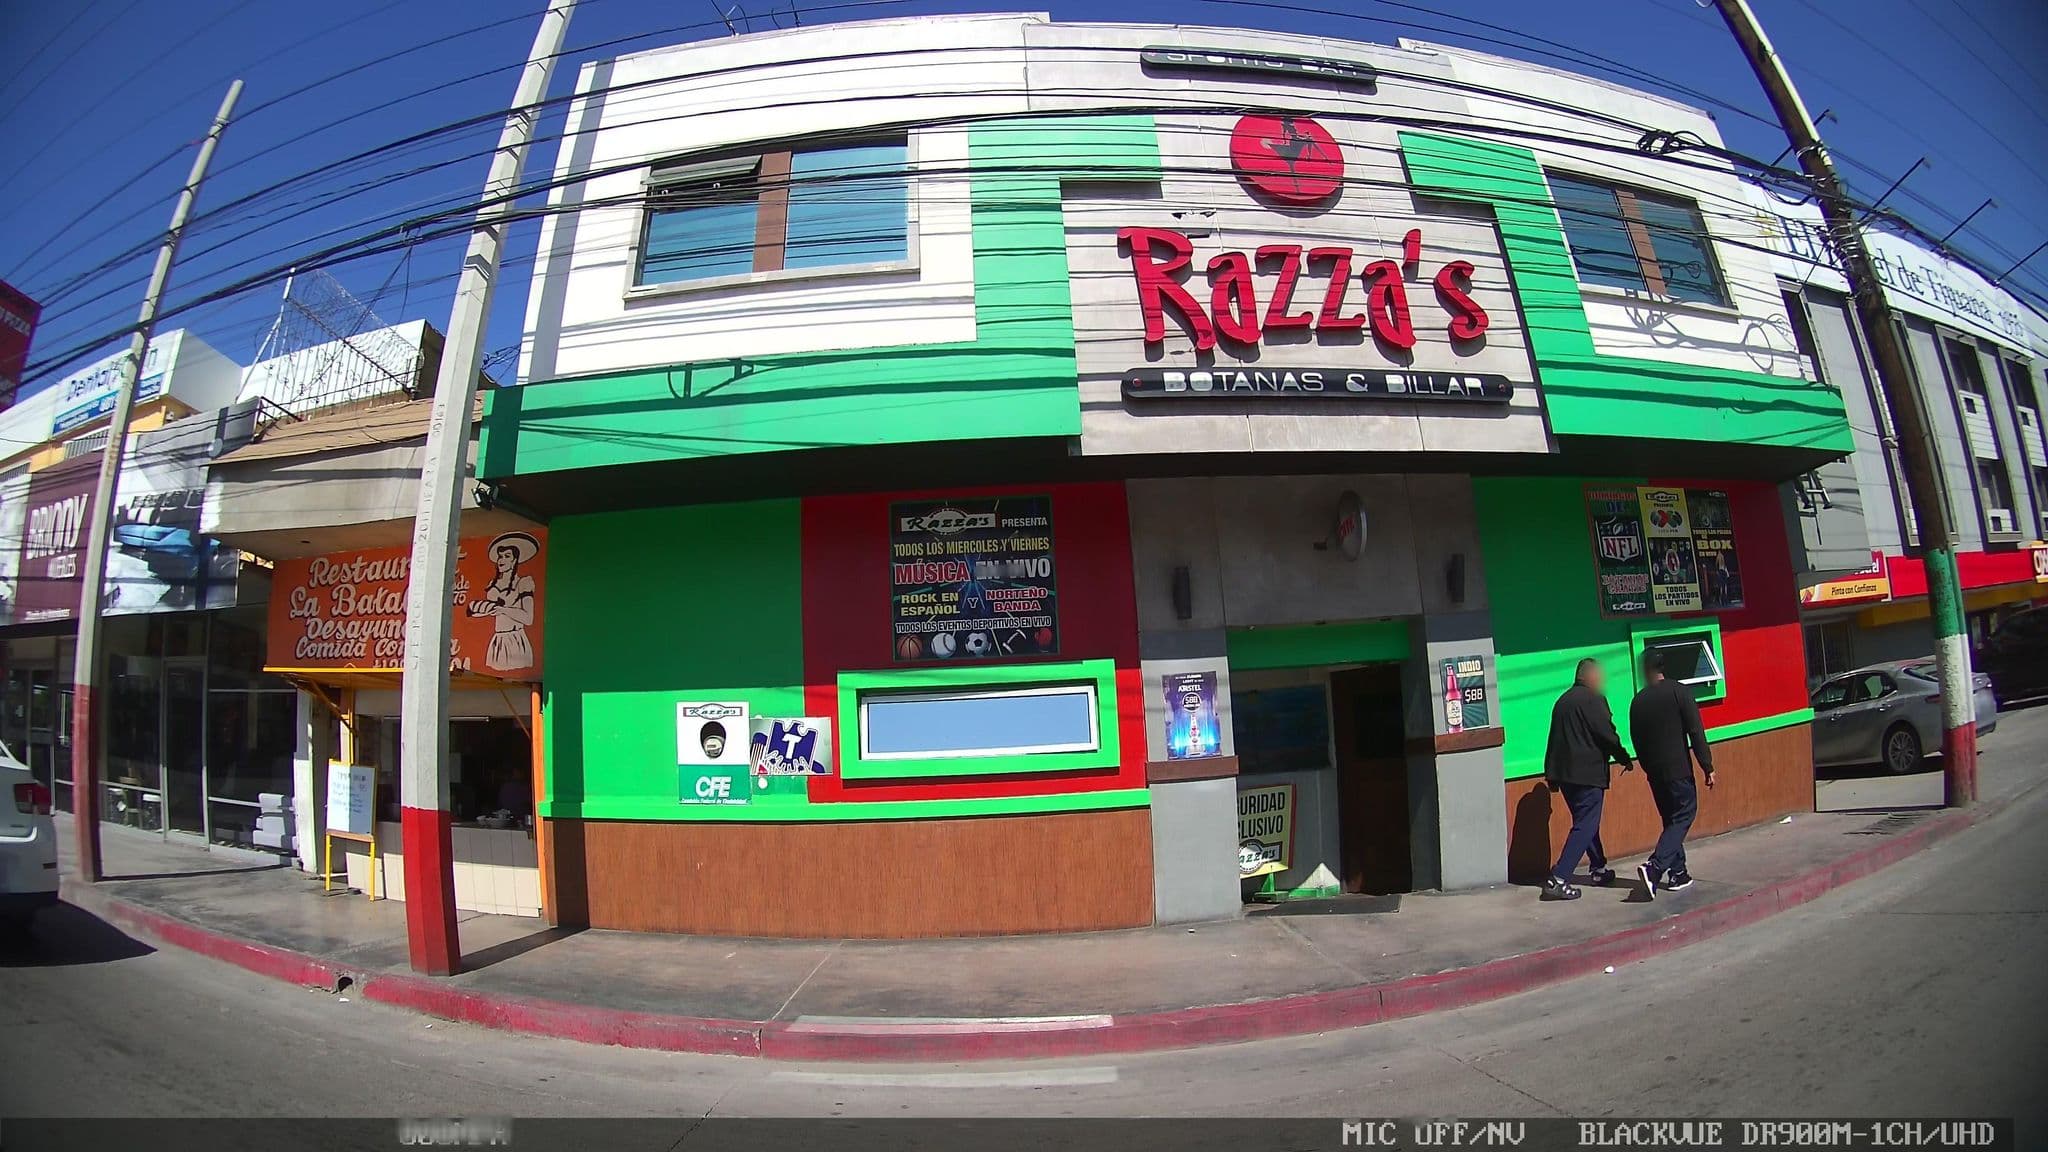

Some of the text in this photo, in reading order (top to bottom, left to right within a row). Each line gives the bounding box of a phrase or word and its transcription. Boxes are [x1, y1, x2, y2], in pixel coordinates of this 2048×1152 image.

[1117, 226, 1490, 350] Razza's
[1163, 371, 1486, 397] BOTANAS & BILLAR
[1002, 517, 1048, 528] PRESENTA
[894, 536, 1050, 557] TODOS LOS MIERCOLES Y VIERNES
[1604, 536, 1638, 559] NFL
[1697, 540, 1733, 550] BOX
[894, 559, 971, 584] MÚSICA
[901, 592, 959, 604] ROCK EN
[985, 587, 1048, 600] NORTEÑO
[1668, 591, 1699, 600] PARTIDOS
[290, 586, 320, 620] La
[967, 597, 979, 609] Y
[994, 600, 1041, 613] BANDA
[1675, 598, 1690, 606] VIVO
[901, 603, 960, 616] ESPAÑOL
[896, 616, 1052, 633] TODOS LOS EVENTOS DEPORTIVOS EN VIVO
[296, 636, 366, 660] Comida
[1458, 660, 1481, 673] INDIO
[695, 776, 732, 798] CFE
